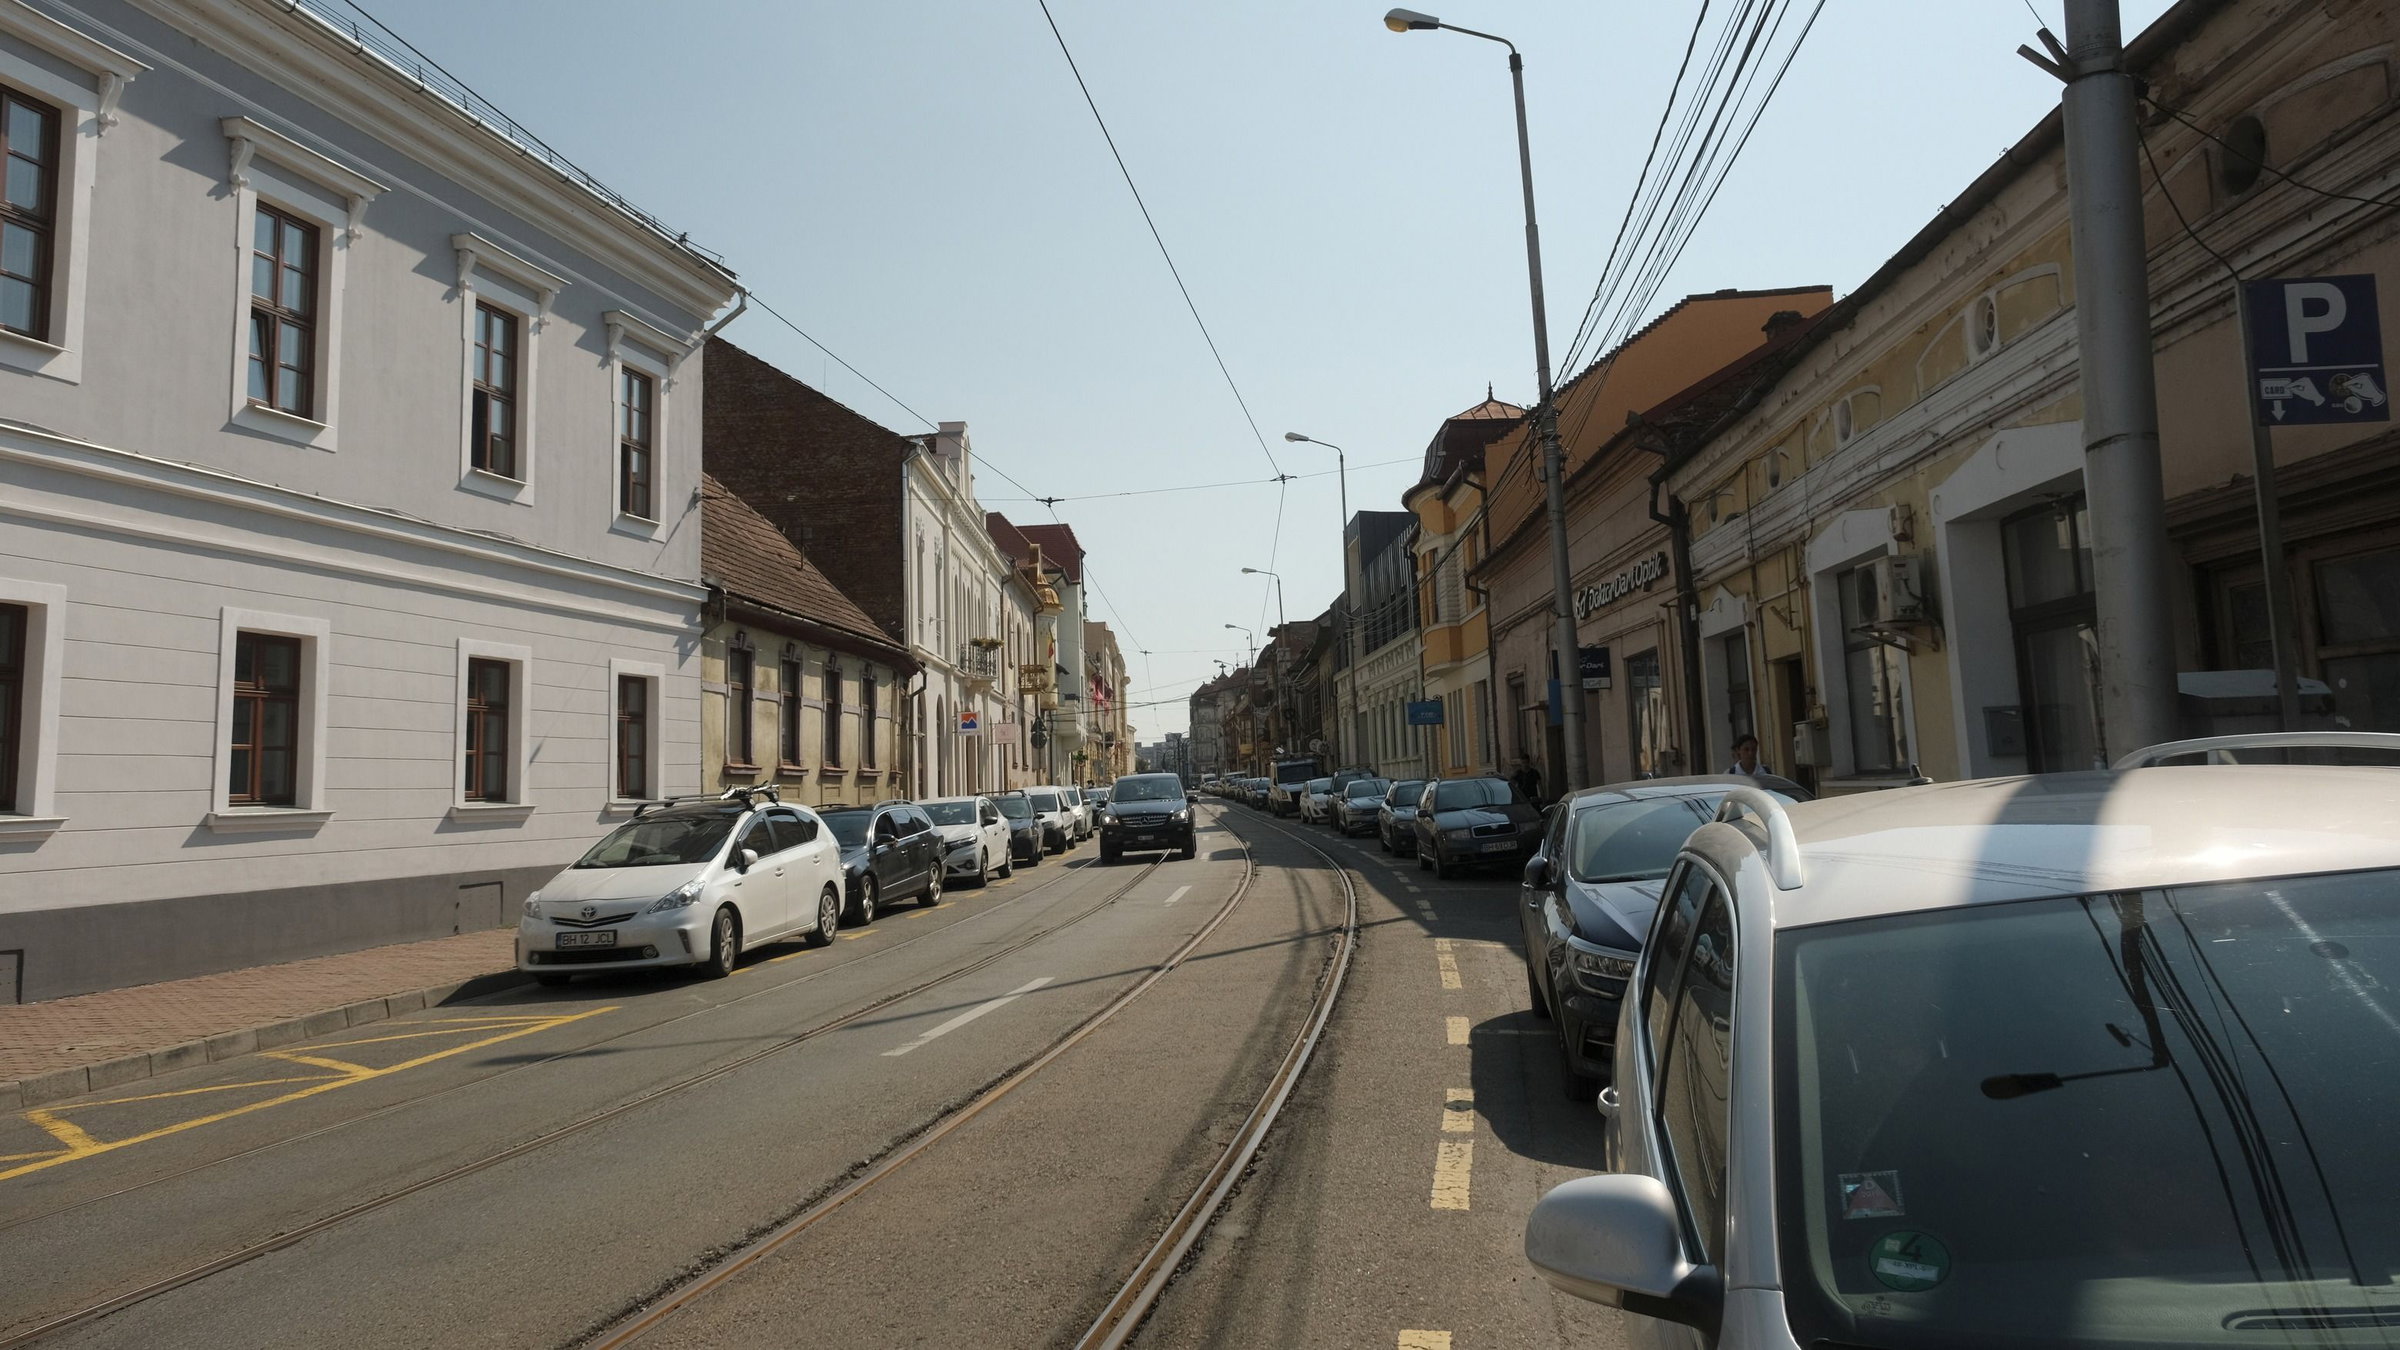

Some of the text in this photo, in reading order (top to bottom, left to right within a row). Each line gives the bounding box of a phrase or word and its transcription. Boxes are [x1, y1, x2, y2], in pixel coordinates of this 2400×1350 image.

[2284, 282, 2347, 364] P
[1635, 552, 1662, 592] Optik
[562, 932, 613, 946] BH 12 JCL
[1899, 1233, 1923, 1261] 4
